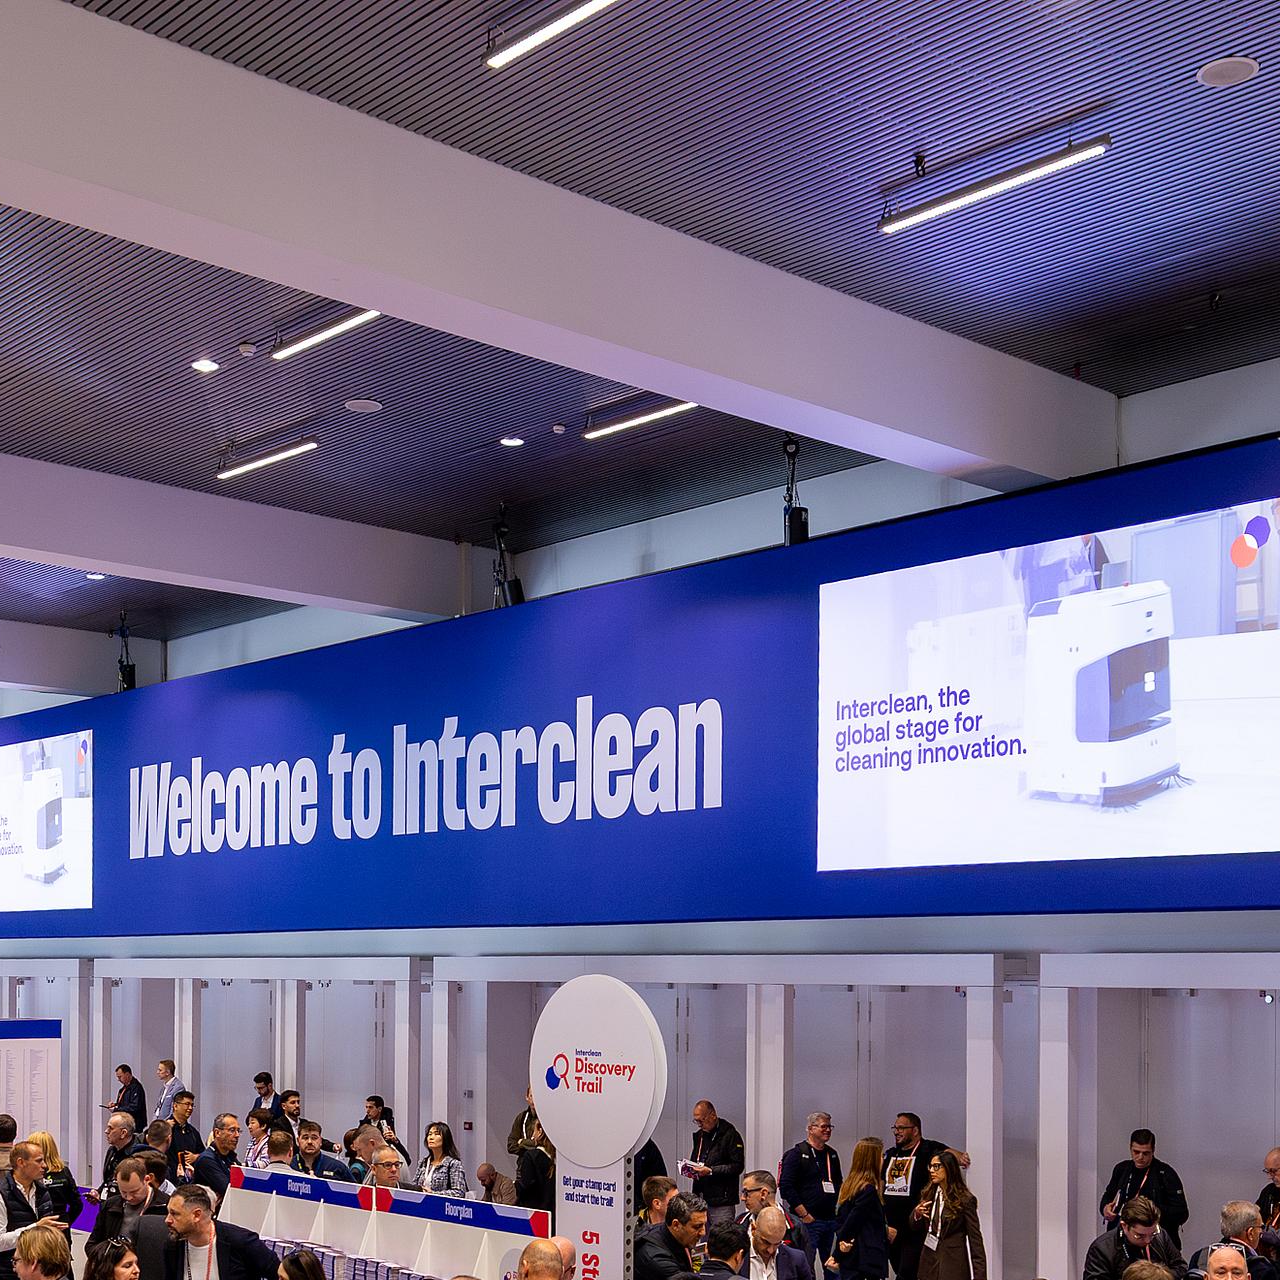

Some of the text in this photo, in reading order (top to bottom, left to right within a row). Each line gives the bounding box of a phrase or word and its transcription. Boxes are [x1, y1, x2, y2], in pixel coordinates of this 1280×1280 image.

[836, 686, 969, 721] Interclean, the
[836, 711, 982, 751] global stage for
[836, 736, 1026, 772] cleaning innovation.
[129, 696, 720, 859] Welcome to Interclean
[3, 829, 12, 840] for
[575, 1049, 602, 1057] Interclean
[575, 1058, 636, 1082] Discovery
[575, 1076, 602, 1094] Trail
[288, 1179, 311, 1195] Floorplan
[563, 1176, 617, 1193] Get your stamp card
[565, 1191, 575, 1201] and
[575, 1193, 590, 1204] start
[590, 1194, 600, 1205] the
[446, 1202, 473, 1220] Floorplan
[582, 1231, 600, 1245] 5
